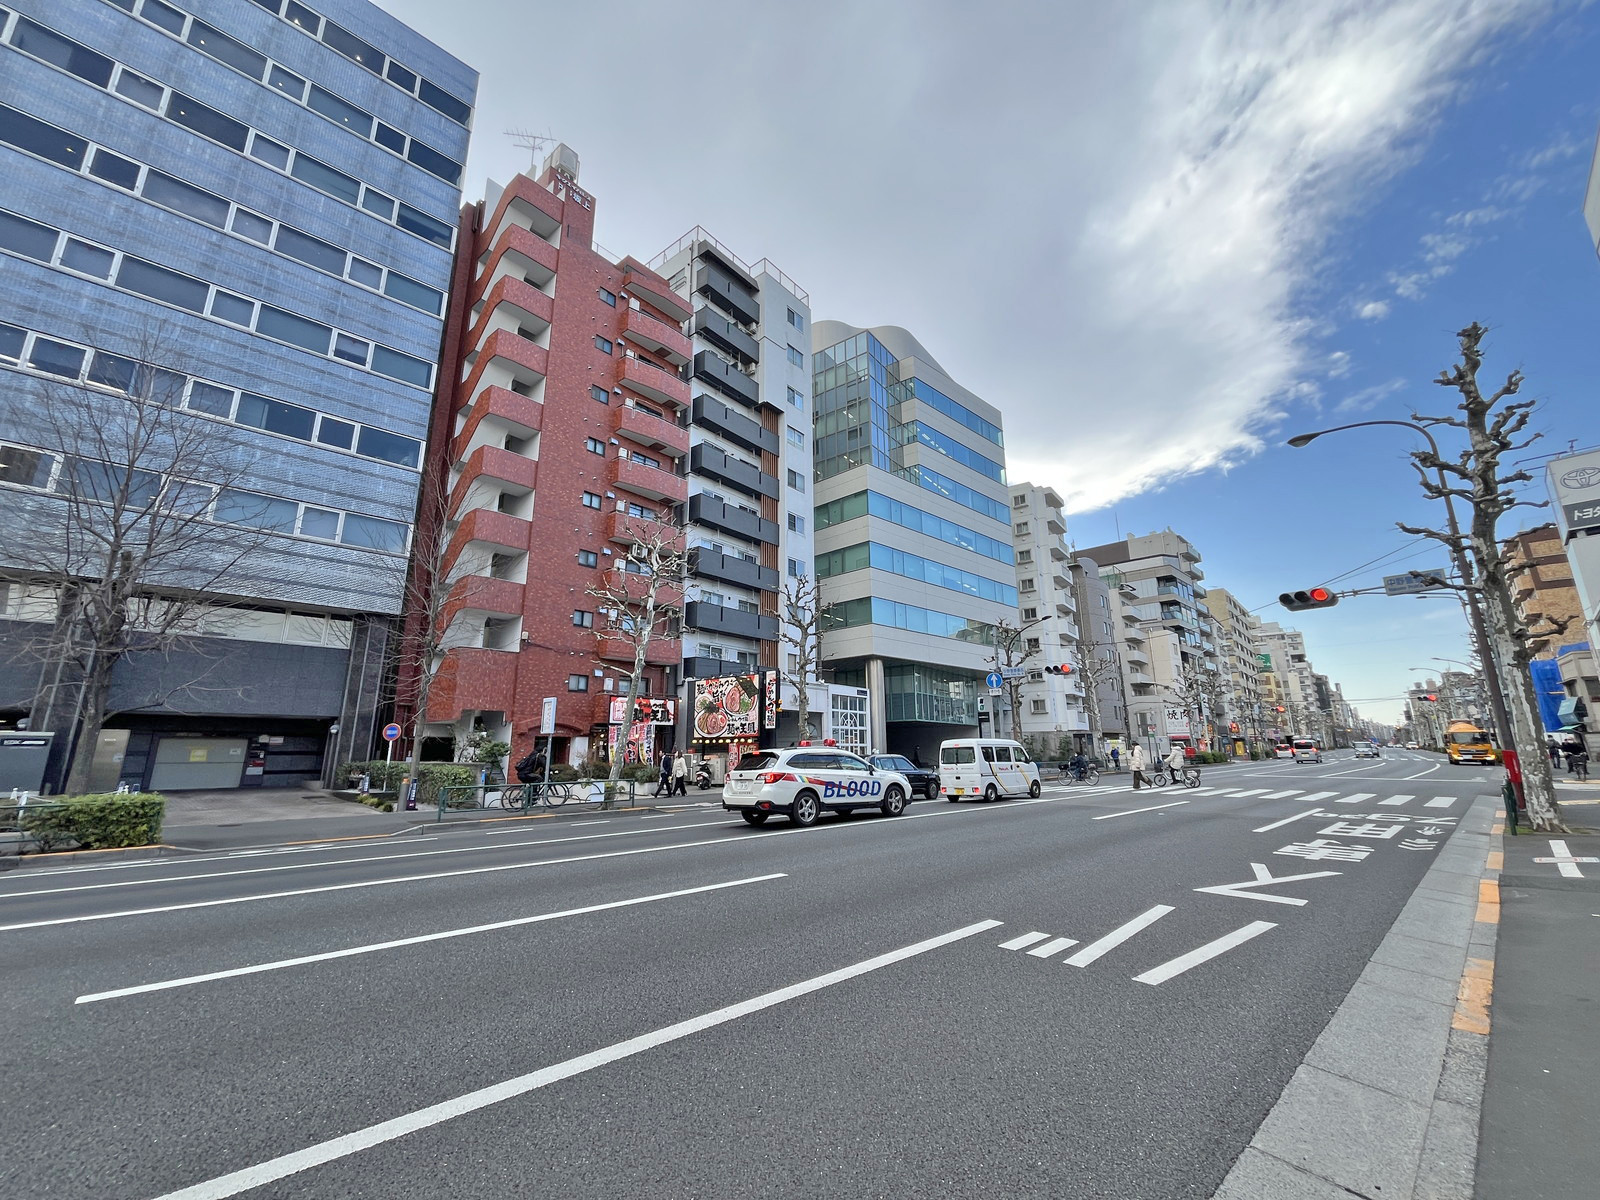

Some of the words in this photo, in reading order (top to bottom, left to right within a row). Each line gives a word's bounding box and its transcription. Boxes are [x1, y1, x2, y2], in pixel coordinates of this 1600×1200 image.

[1574, 507, 1600, 521] トヨタ
[823, 780, 881, 798] BLOOD
